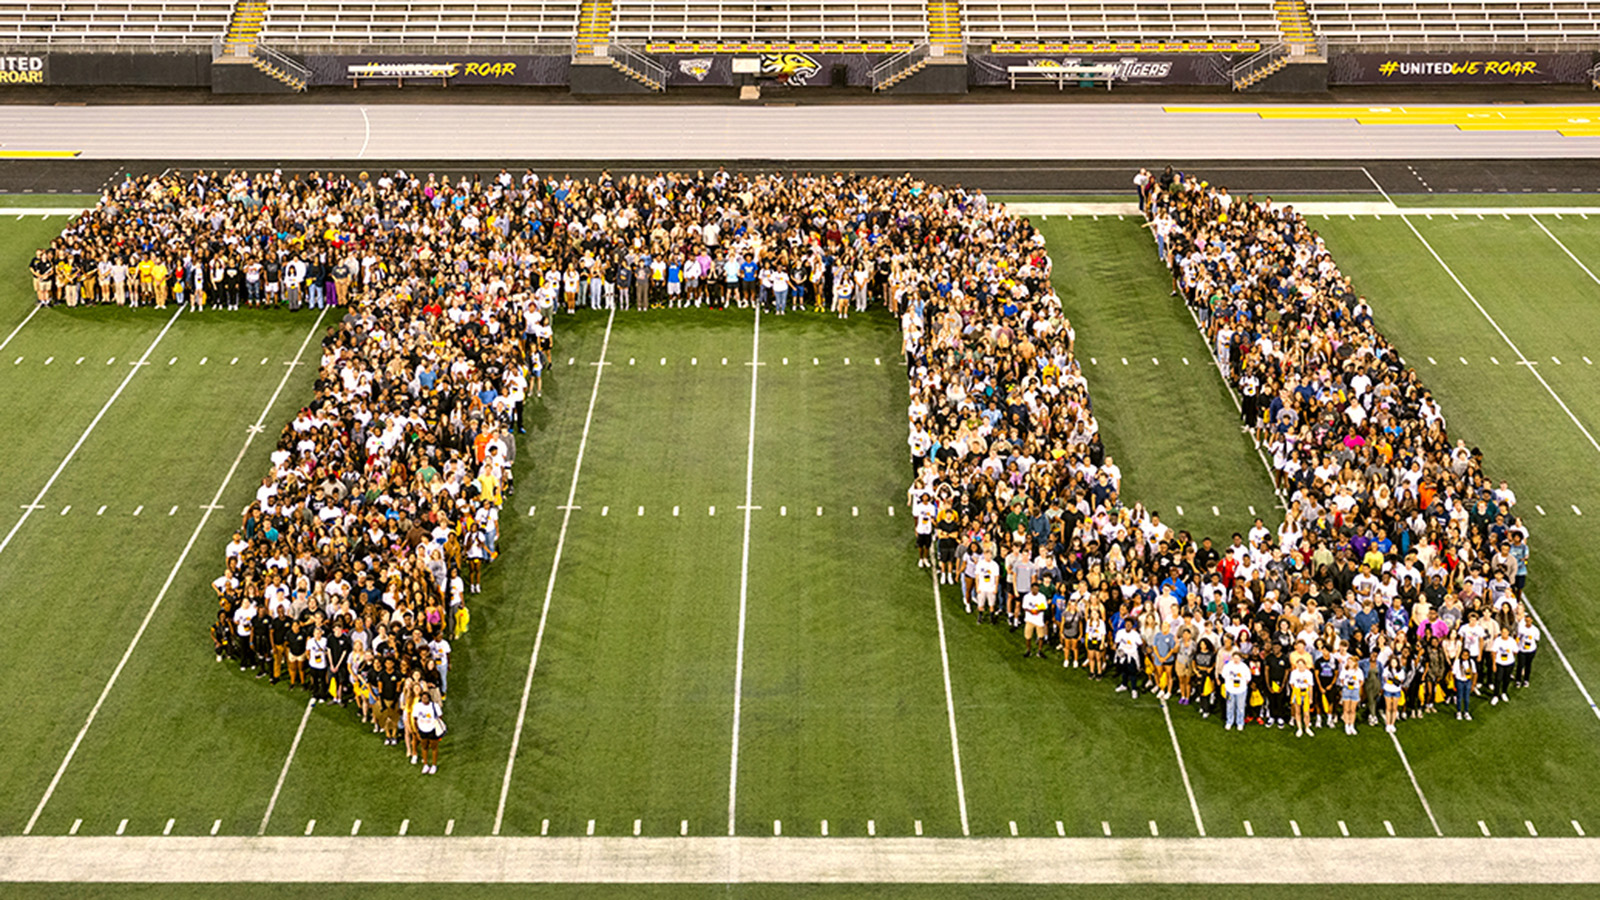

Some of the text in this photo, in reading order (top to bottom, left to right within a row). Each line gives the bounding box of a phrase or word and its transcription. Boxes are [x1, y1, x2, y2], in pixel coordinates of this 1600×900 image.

[464, 62, 517, 77] ROAR
[1120, 58, 1171, 80] TIGERS
[1484, 61, 1537, 77] ROAR
